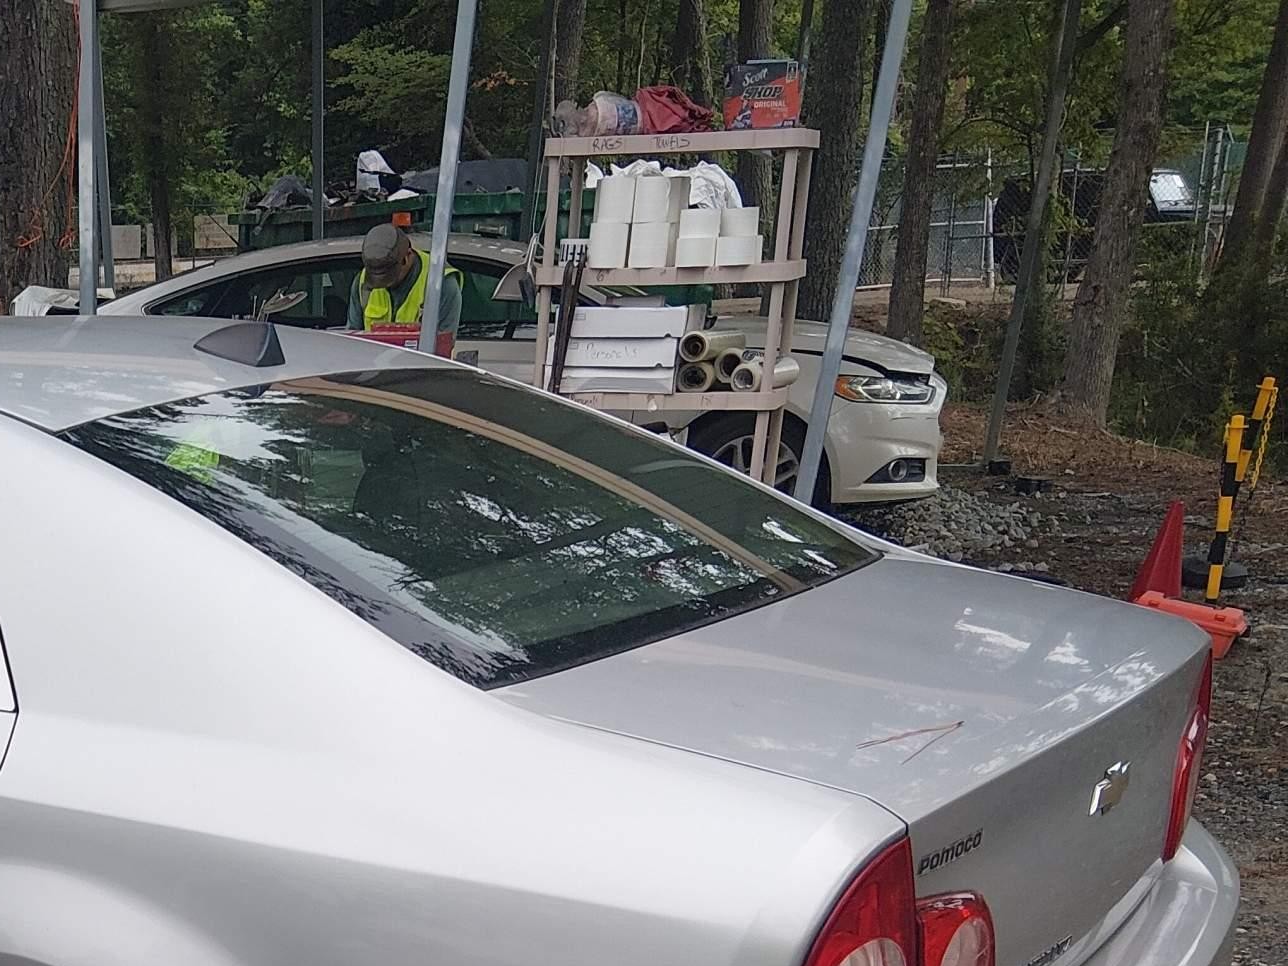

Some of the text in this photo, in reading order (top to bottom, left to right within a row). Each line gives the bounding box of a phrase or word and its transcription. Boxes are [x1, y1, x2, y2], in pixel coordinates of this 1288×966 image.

[742, 68, 768, 87] Scott
[743, 85, 785, 100] SHOP
[753, 101, 786, 109] ORIGINAL
